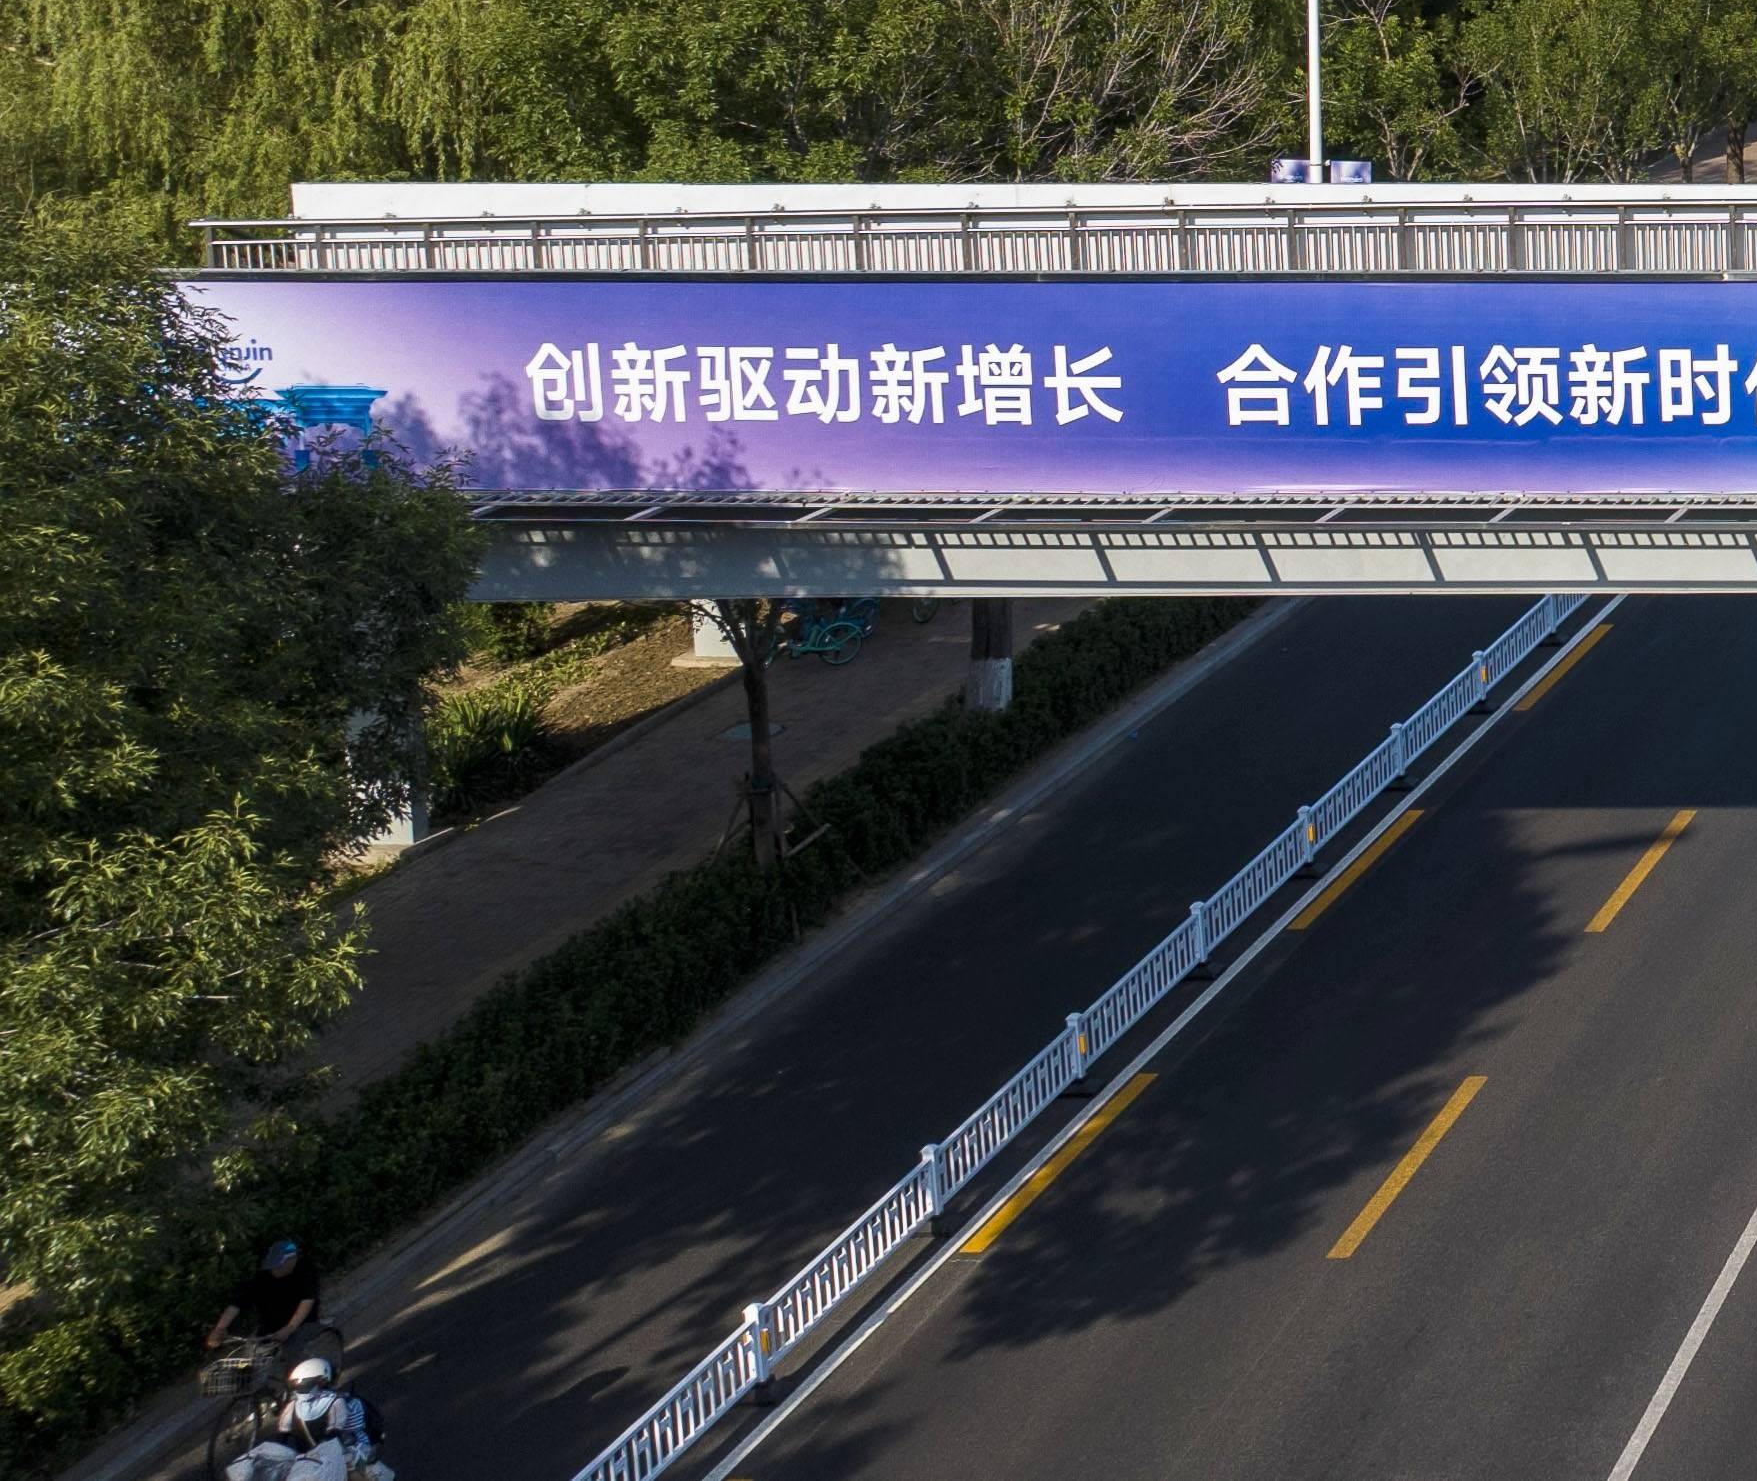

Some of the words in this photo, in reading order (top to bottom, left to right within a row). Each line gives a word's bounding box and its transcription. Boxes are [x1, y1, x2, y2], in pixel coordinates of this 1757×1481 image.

[526, 342, 1124, 425] 创新驱动新增长
